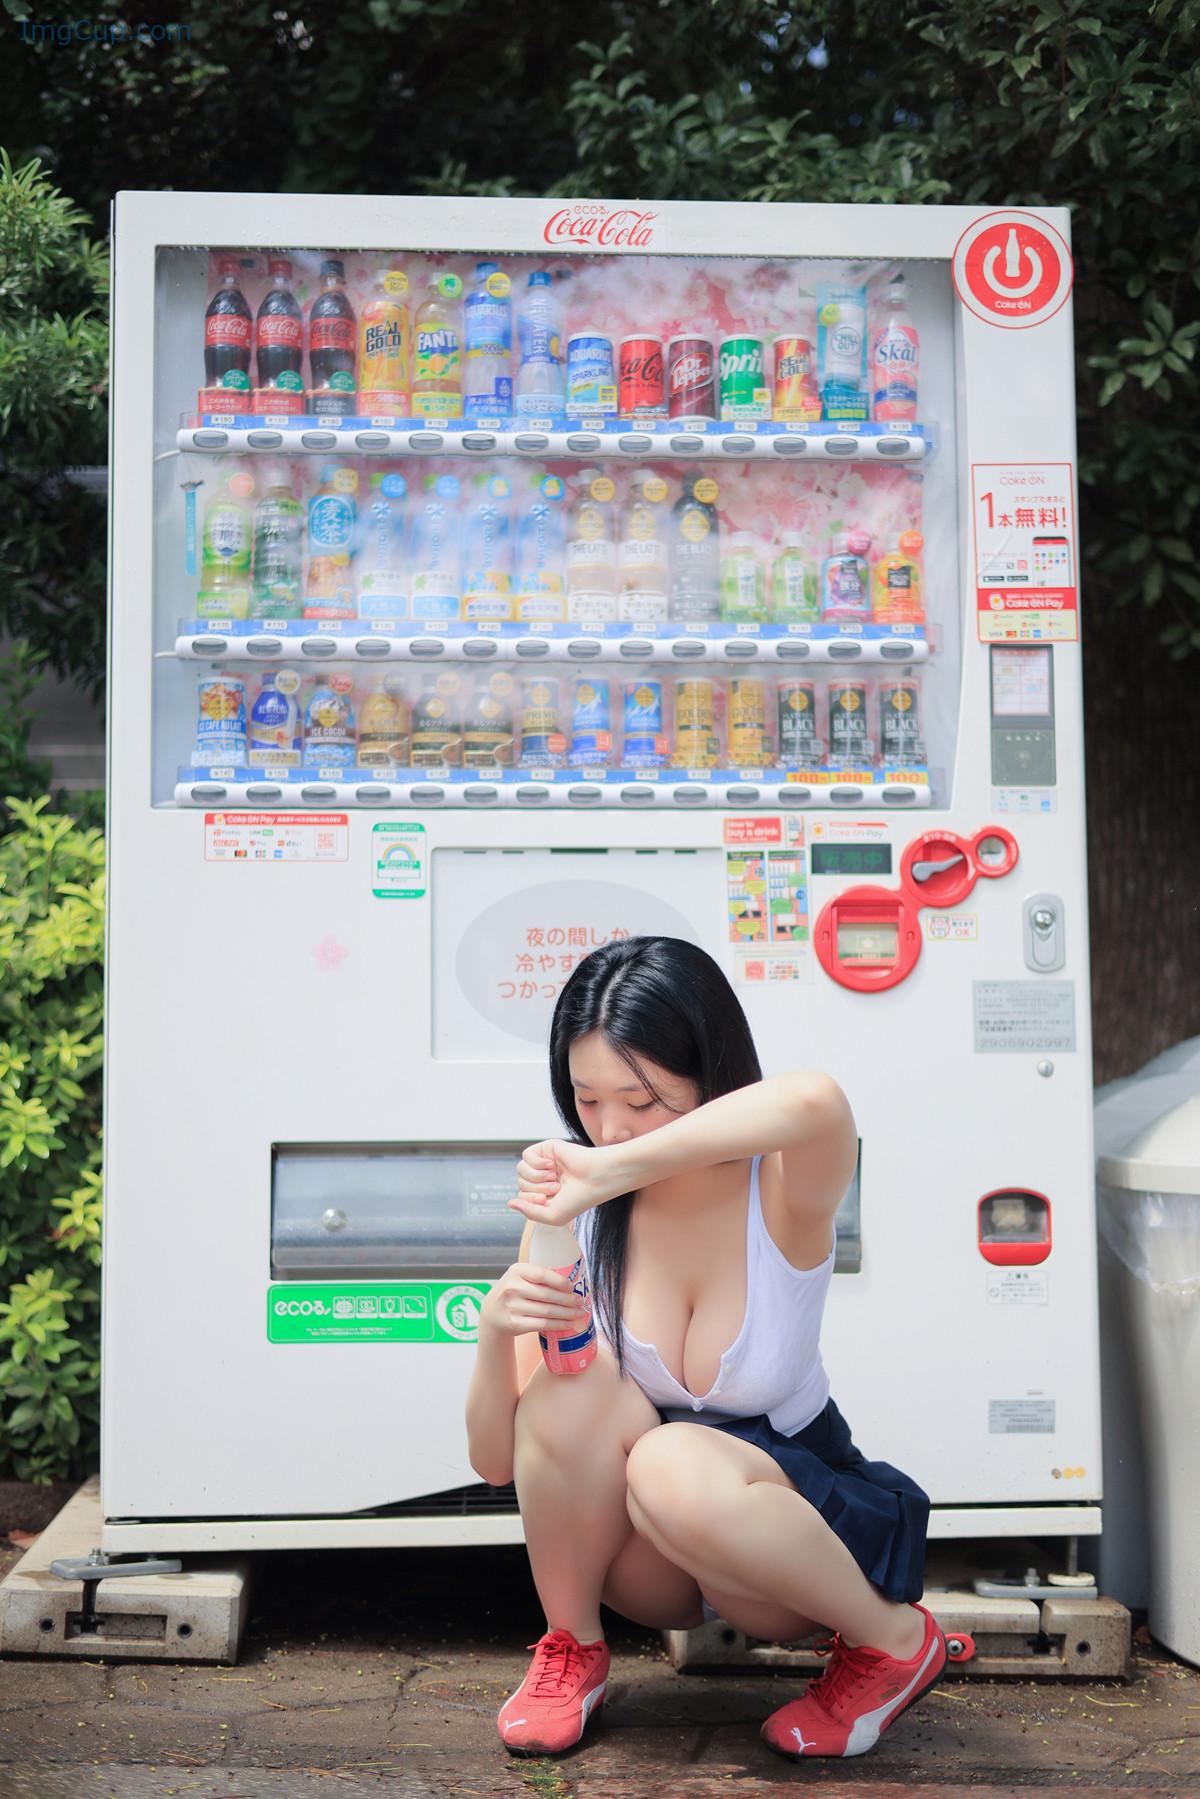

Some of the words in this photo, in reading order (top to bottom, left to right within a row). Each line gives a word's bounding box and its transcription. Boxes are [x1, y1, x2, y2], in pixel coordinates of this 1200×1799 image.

[366, 321, 401, 341] REAL
[366, 334, 401, 352] GOLD
[980, 492, 1067, 529] 1本無料!
[1046, 600, 1064, 609] Pay
[528, 928, 631, 948] 夜の間しか
[498, 981, 569, 999] つかっ
